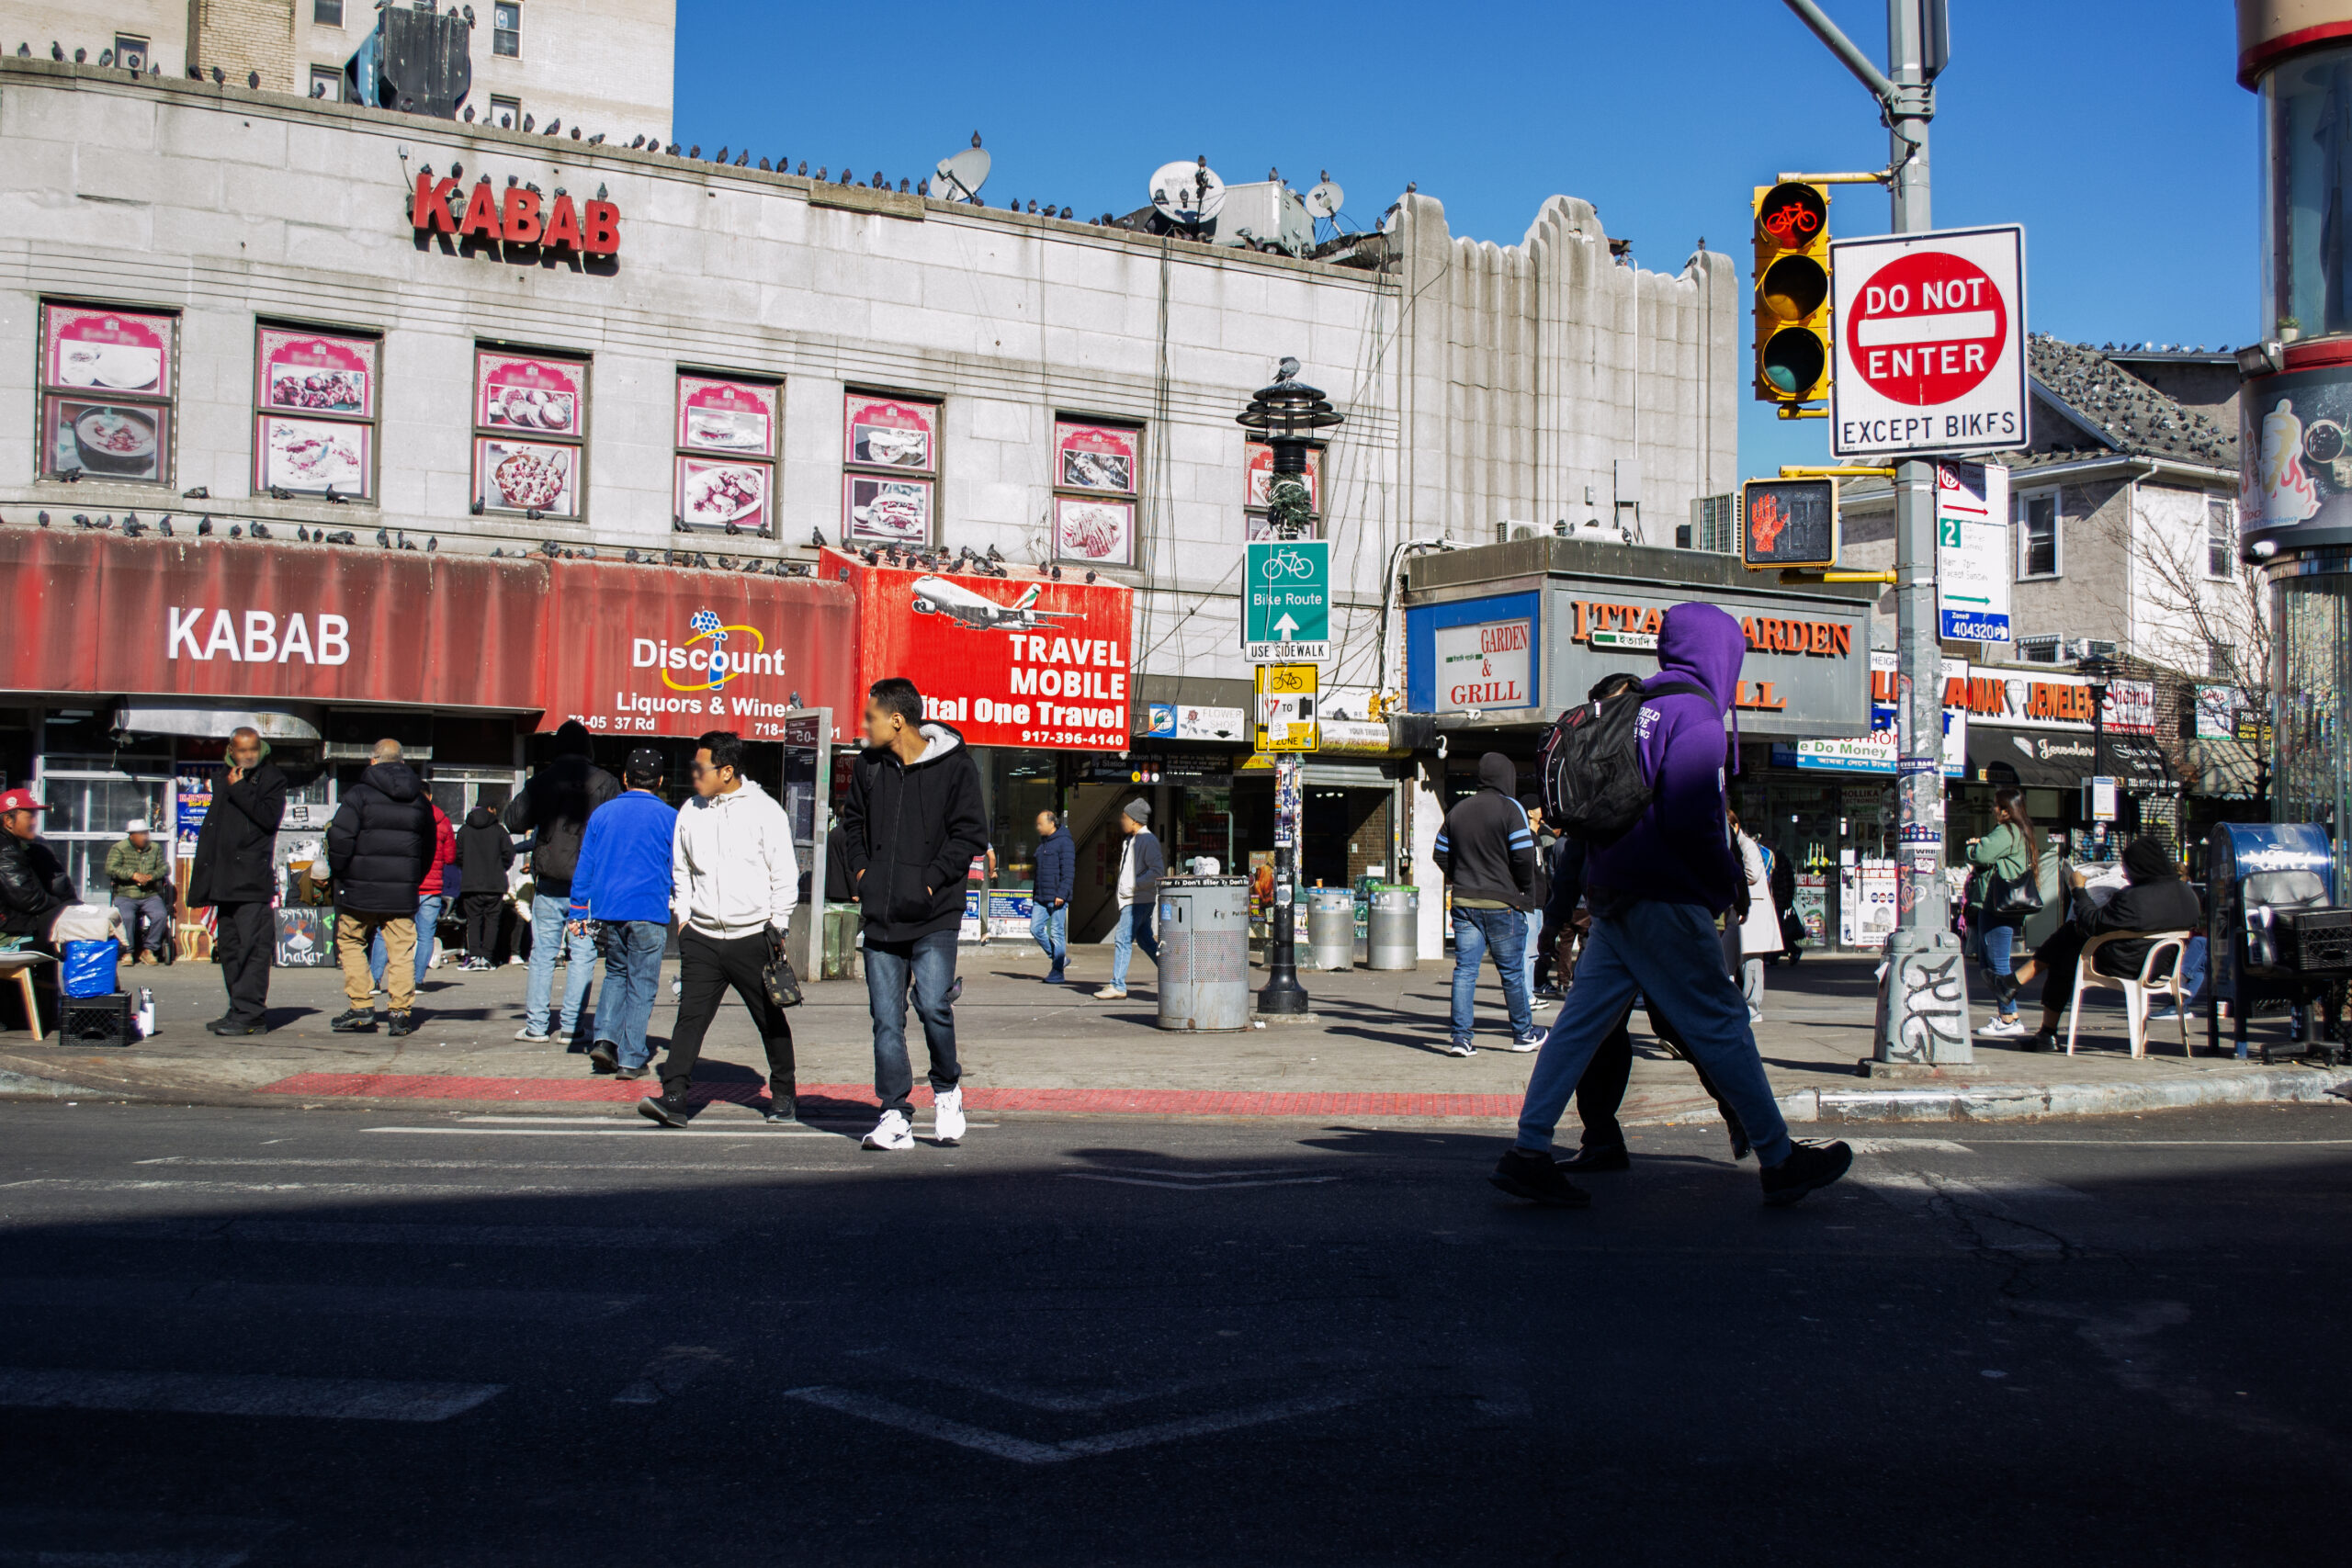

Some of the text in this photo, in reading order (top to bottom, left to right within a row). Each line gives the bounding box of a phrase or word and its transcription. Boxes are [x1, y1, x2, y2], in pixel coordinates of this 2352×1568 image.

[413, 173, 620, 255] KABAB
[1866, 277, 1984, 315] DO NOT
[1869, 344, 1985, 379] ENTER
[1843, 416, 1933, 445] EXCEPT
[1944, 521, 1956, 546] 2
[1253, 592, 1322, 605] Bike Route
[1570, 600, 1662, 641] ITTA
[1952, 621, 1994, 637] 404320
[168, 606, 351, 666] KABAB
[1481, 625, 1528, 654] GARDEN
[1742, 615, 1853, 655] ARDEN
[633, 637, 786, 676] Discount
[1009, 634, 1125, 668] TRAVEL
[1251, 644, 1324, 658] USE SIDEWALK
[1481, 658, 1492, 677] &
[1010, 667, 1125, 701] MOBILE
[1451, 681, 1521, 705] GRILL
[1971, 676, 2005, 714] MAR
[616, 691, 795, 719] Liquors & Wines
[974, 697, 1031, 726] One
[1035, 701, 1125, 729] Travel
[1203, 708, 1242, 718] FLOWER
[1282, 703, 1293, 713] TO
[1638, 706, 1661, 722] ORLD
[614, 716, 631, 730] 37
[636, 716, 656, 731] Rd
[1210, 720, 1237, 729] SHOP
[1022, 730, 1124, 746] 917-396-4140
[1275, 737, 1298, 746] ZONE
[1786, 740, 1888, 759] We Do Money
[277, 941, 324, 967] Lhakar
